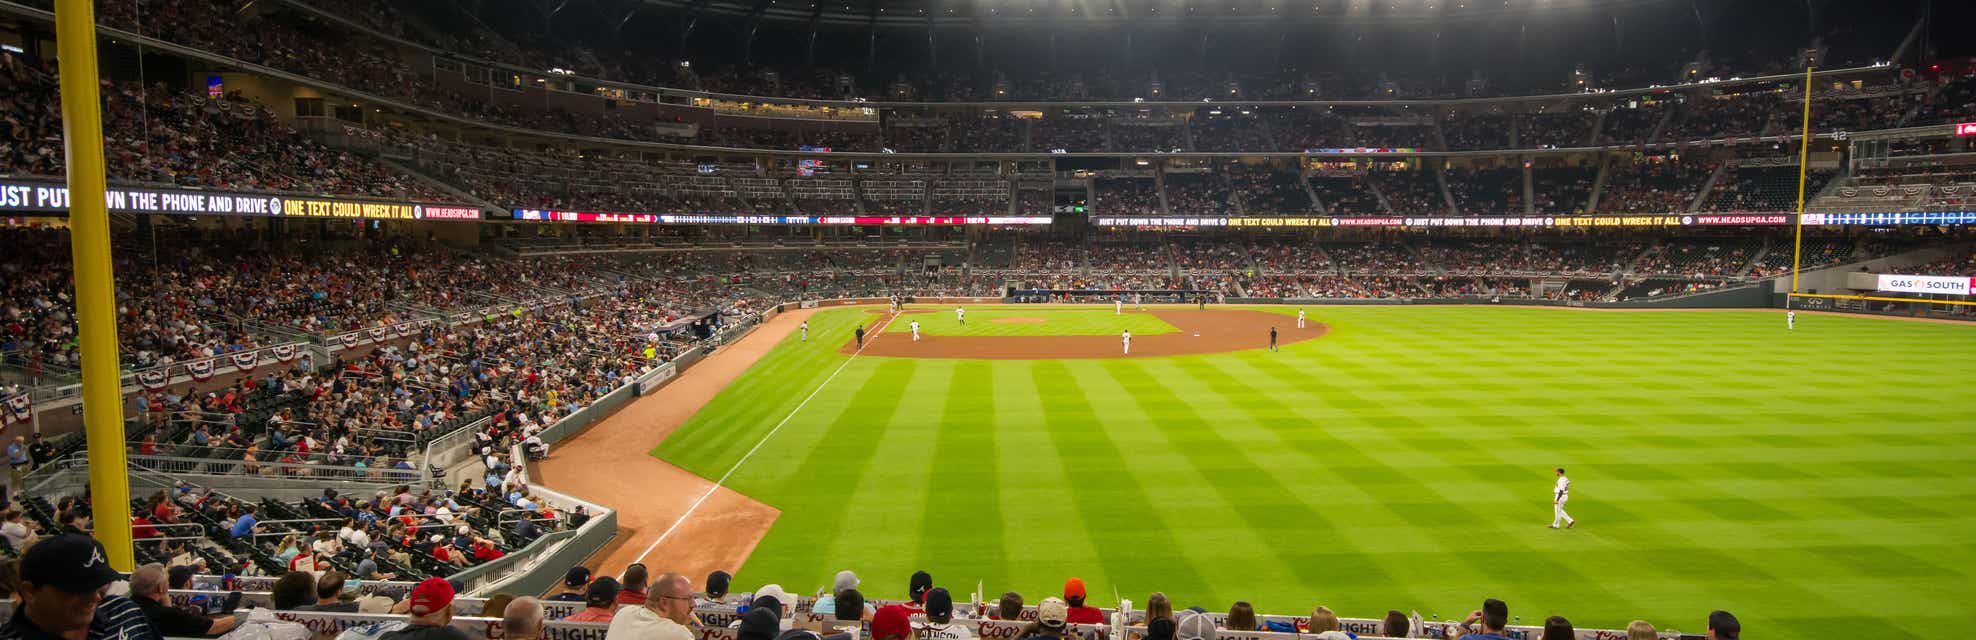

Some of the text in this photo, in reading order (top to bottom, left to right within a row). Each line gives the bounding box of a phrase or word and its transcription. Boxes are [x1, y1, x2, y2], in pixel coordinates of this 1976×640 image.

[1831, 131, 1846, 141] 42
[0, 185, 30, 207] UST
[37, 187, 70, 208] PUT
[129, 192, 158, 210] THE
[162, 193, 205, 212] PHONE
[208, 195, 233, 212] AND
[236, 197, 268, 214] DRIVE
[284, 199, 414, 219] ONE TEXT COULD WRECK IT ALL
[1099, 218, 1114, 226] JUST
[1115, 218, 1129, 226] PUT
[1150, 218, 1162, 226] THE
[1185, 218, 1199, 226] AND
[1200, 218, 1219, 226] DRIVE
[1228, 218, 1331, 226] ONE TEXT COULD WRECK IT ALL
[1413, 218, 1544, 226] JUST PUT DOWN THE PHONE AND DRIVE
[1555, 216, 1681, 226] ONE TEXT COULD WRECK IT ALL
[1890, 279, 1913, 288] GAS
[1926, 281, 1965, 290] SOUTH
[83, 545, 105, 568] A
[543, 606, 576, 617] GHT
[978, 621, 1020, 638] Coor
